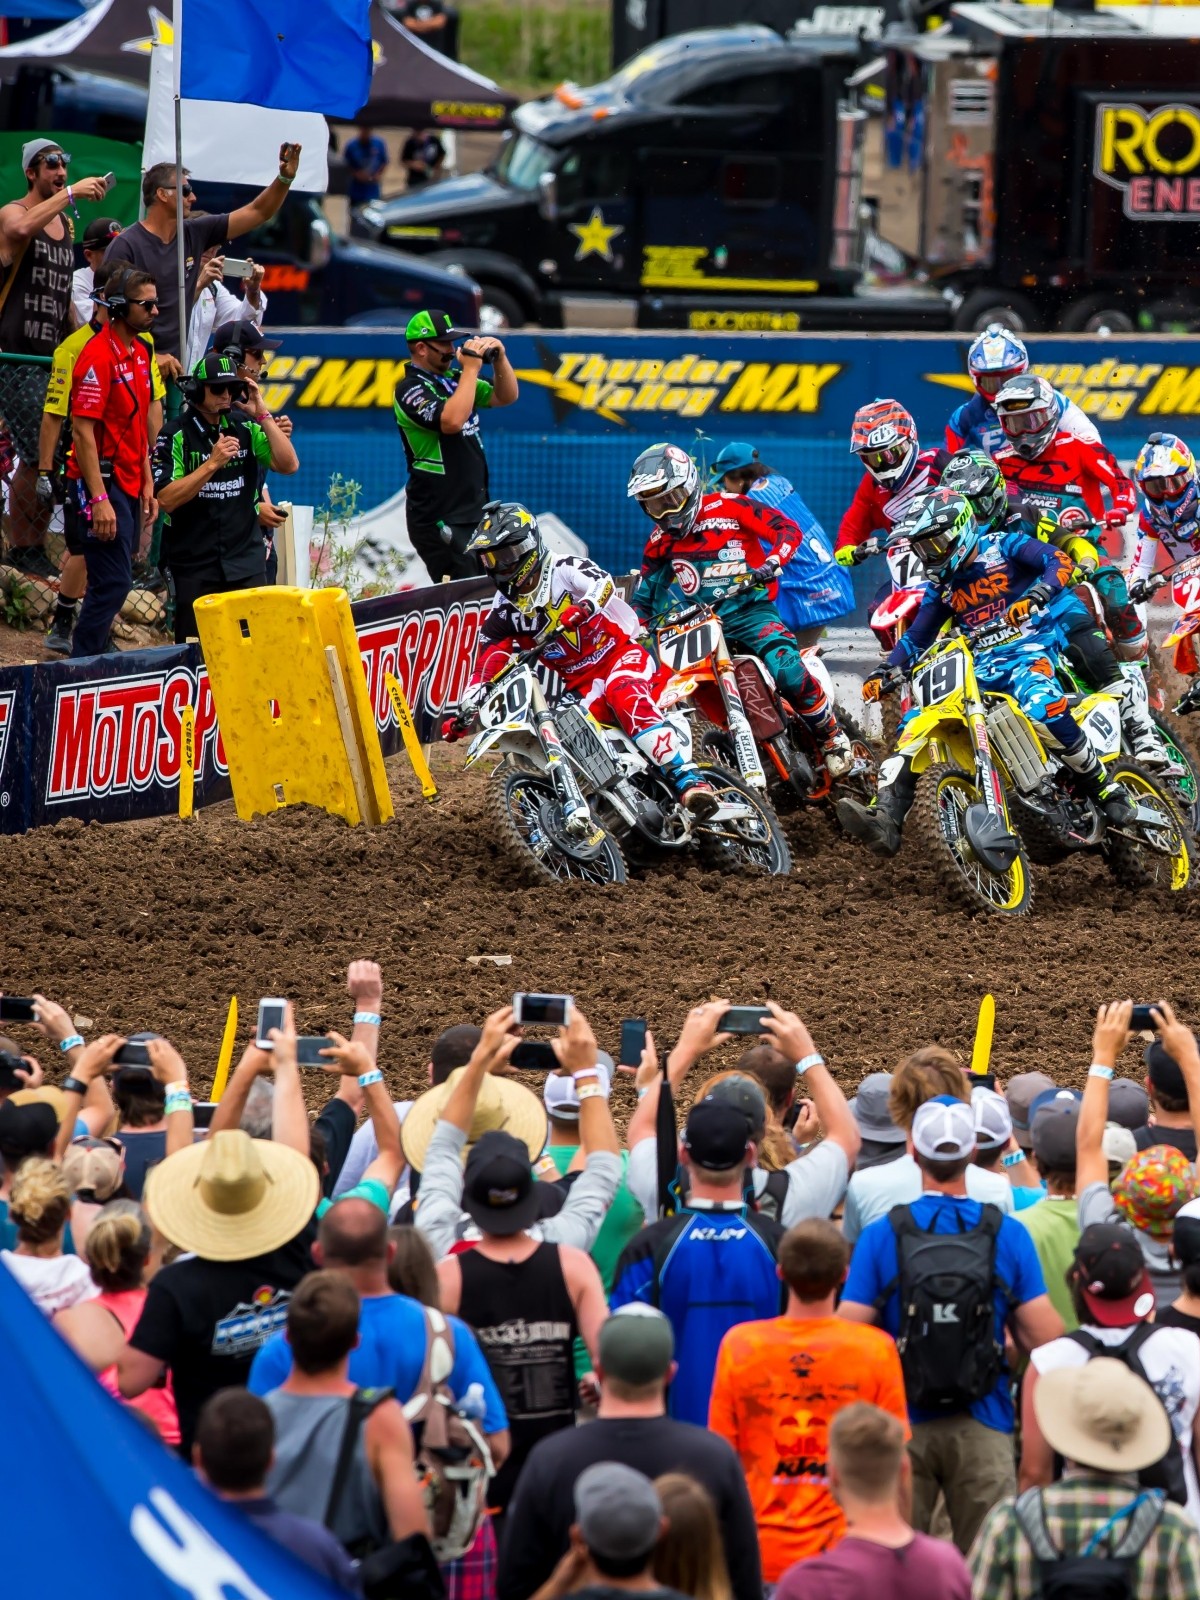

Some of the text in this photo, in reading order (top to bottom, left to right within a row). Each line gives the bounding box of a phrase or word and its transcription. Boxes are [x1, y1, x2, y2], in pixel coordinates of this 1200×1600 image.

[553, 352, 744, 384] Thunder
[1029, 357, 1164, 388] under
[578, 363, 842, 417] Valley MX
[199, 475, 245, 492] awasaki
[702, 562, 748, 578] KTM
[963, 599, 1007, 628] RCH
[356, 600, 492, 730] TOSPOR
[665, 623, 712, 672] 70
[490, 677, 528, 728] 30
[917, 657, 957, 707] 19
[391, 686, 411, 729] ACERBIS
[1088, 710, 1114, 741] 19
[183, 721, 193, 768] ACERBIS
[743, 732, 758, 770] GALFER
[981, 765, 996, 815] DUNLOP
